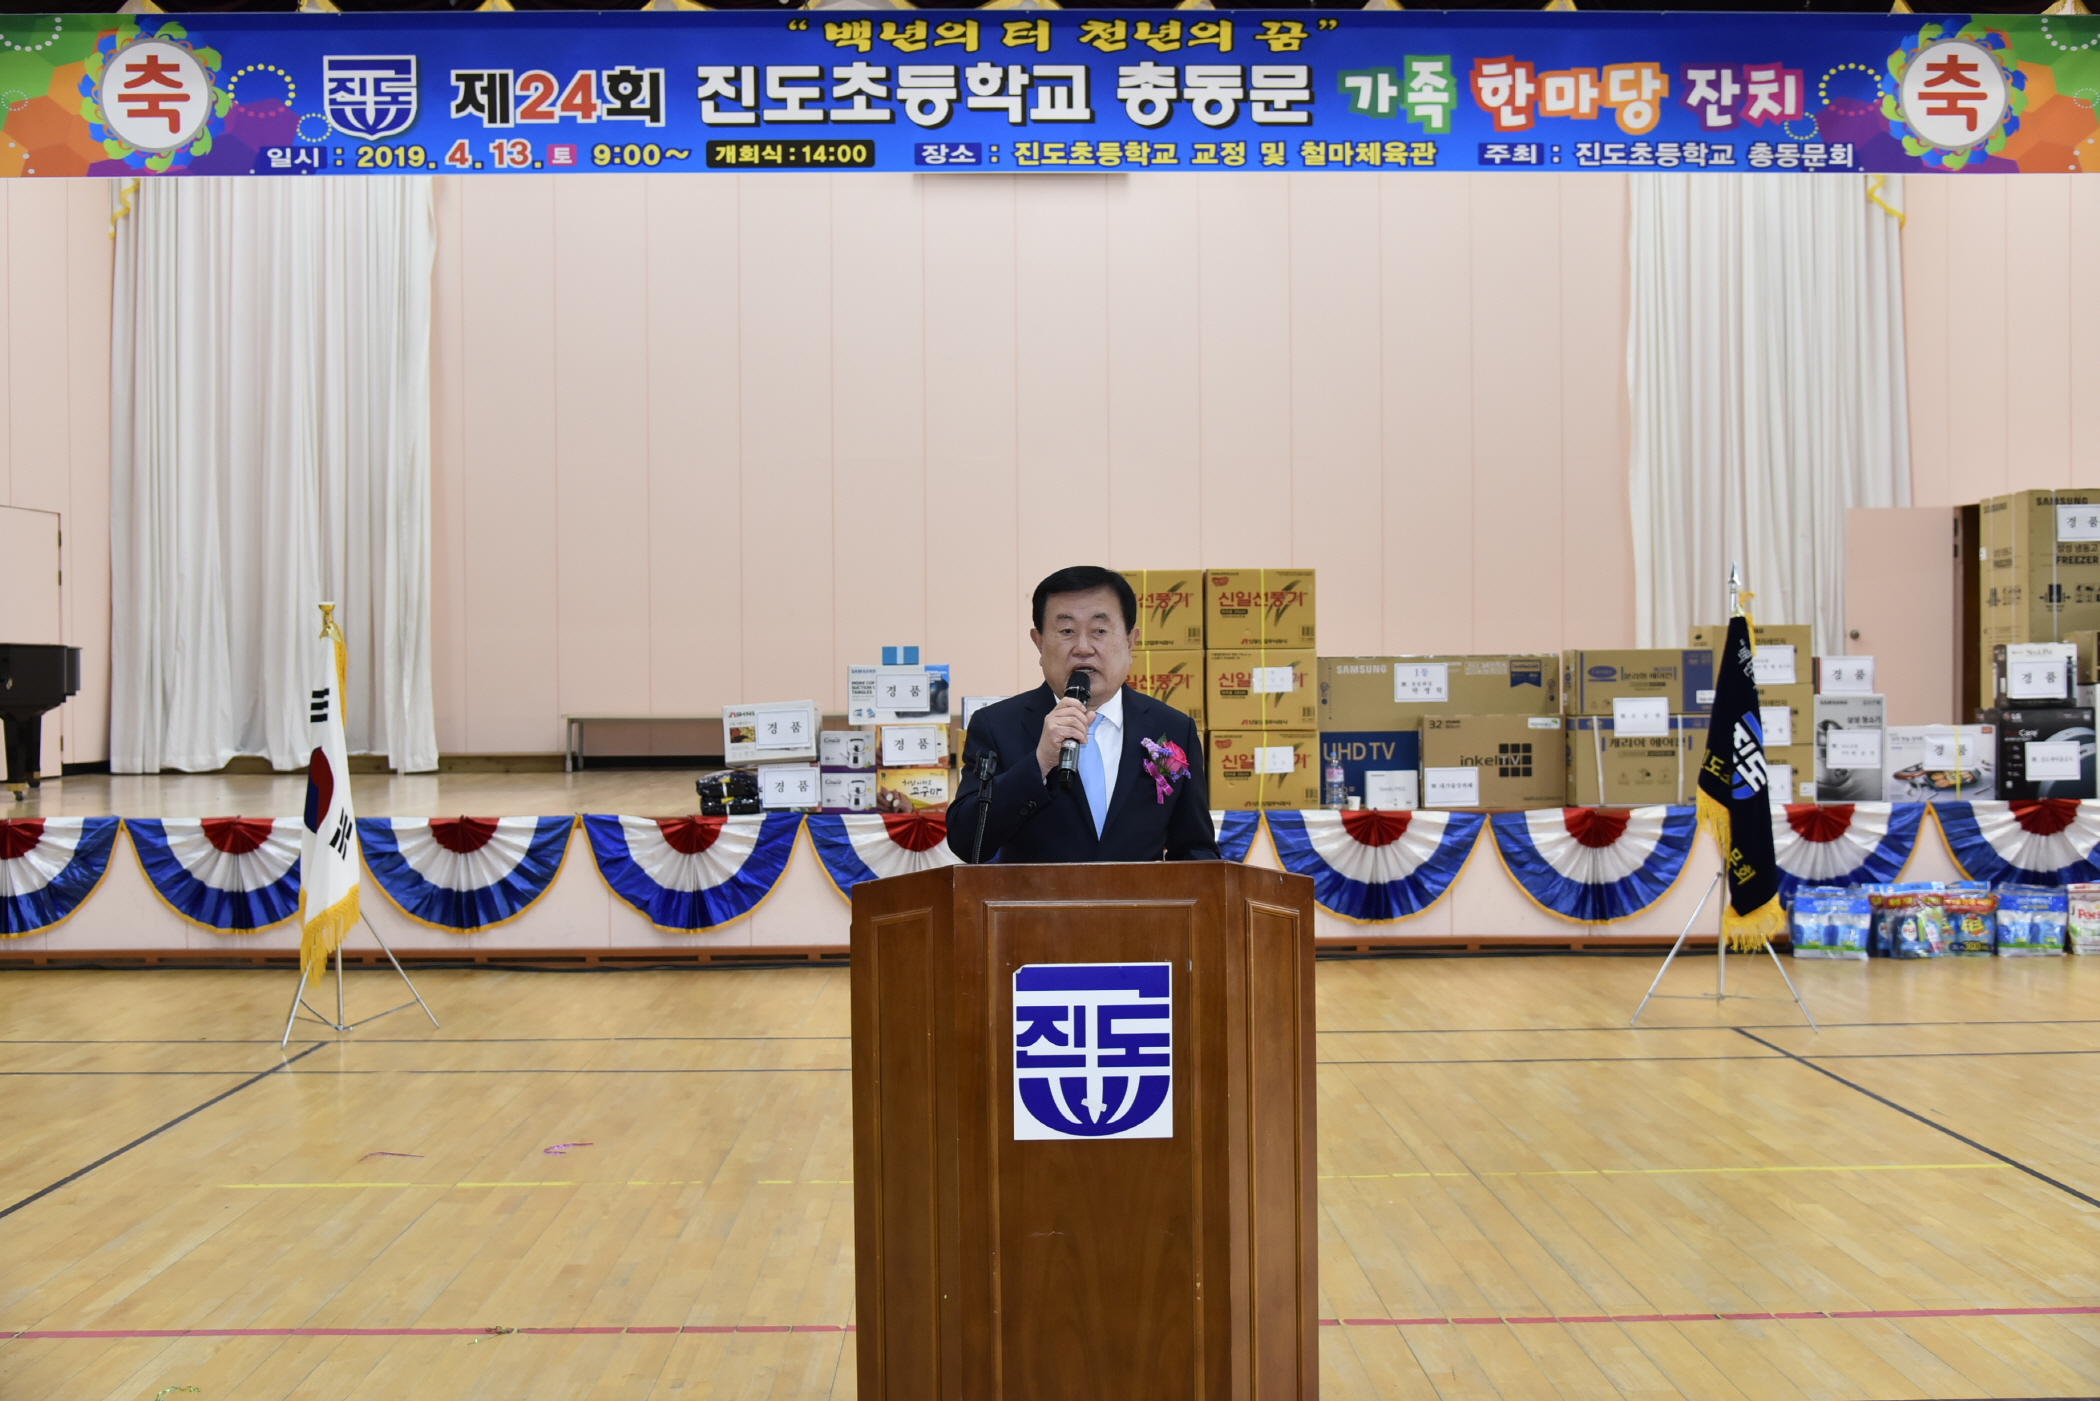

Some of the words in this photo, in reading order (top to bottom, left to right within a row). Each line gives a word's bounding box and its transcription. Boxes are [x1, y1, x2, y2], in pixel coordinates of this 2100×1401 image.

[1001, 19, 1050, 52] 터
[1079, 19, 1233, 52] 천년의
[118, 55, 190, 134] 축
[450, 66, 665, 128] 제24회
[697, 61, 1092, 128] 진도초등학교
[1117, 61, 1311, 128] 총동문
[1345, 61, 1450, 128] 가족
[1477, 62, 1661, 128] 한마당
[1686, 69, 1797, 127] 잔치
[1918, 54, 1988, 132] 축
[267, 147, 319, 168] 일시
[356, 145, 438, 169] 2019.
[552, 146, 574, 165] 토
[921, 144, 976, 164] 장소
[1013, 141, 1179, 167] 진도초등학교
[1191, 141, 1247, 167] 교정
[1260, 141, 1286, 167] 및
[1300, 141, 1438, 167] 철마체육관
[1484, 144, 1537, 164] 주최
[1575, 142, 1735, 167] 진도초등학교
[1748, 142, 1854, 168] 총동문회
[2036, 497, 2088, 506] SAMSUNG
[2056, 556, 2099, 564] FREEZER
[1218, 591, 1303, 608] 신일선풍기
[1337, 665, 1387, 674] SAMSUNG
[1429, 720, 1442, 729] 32
[1610, 737, 1645, 747] 캐리어
[910, 786, 943, 797] 고구마
